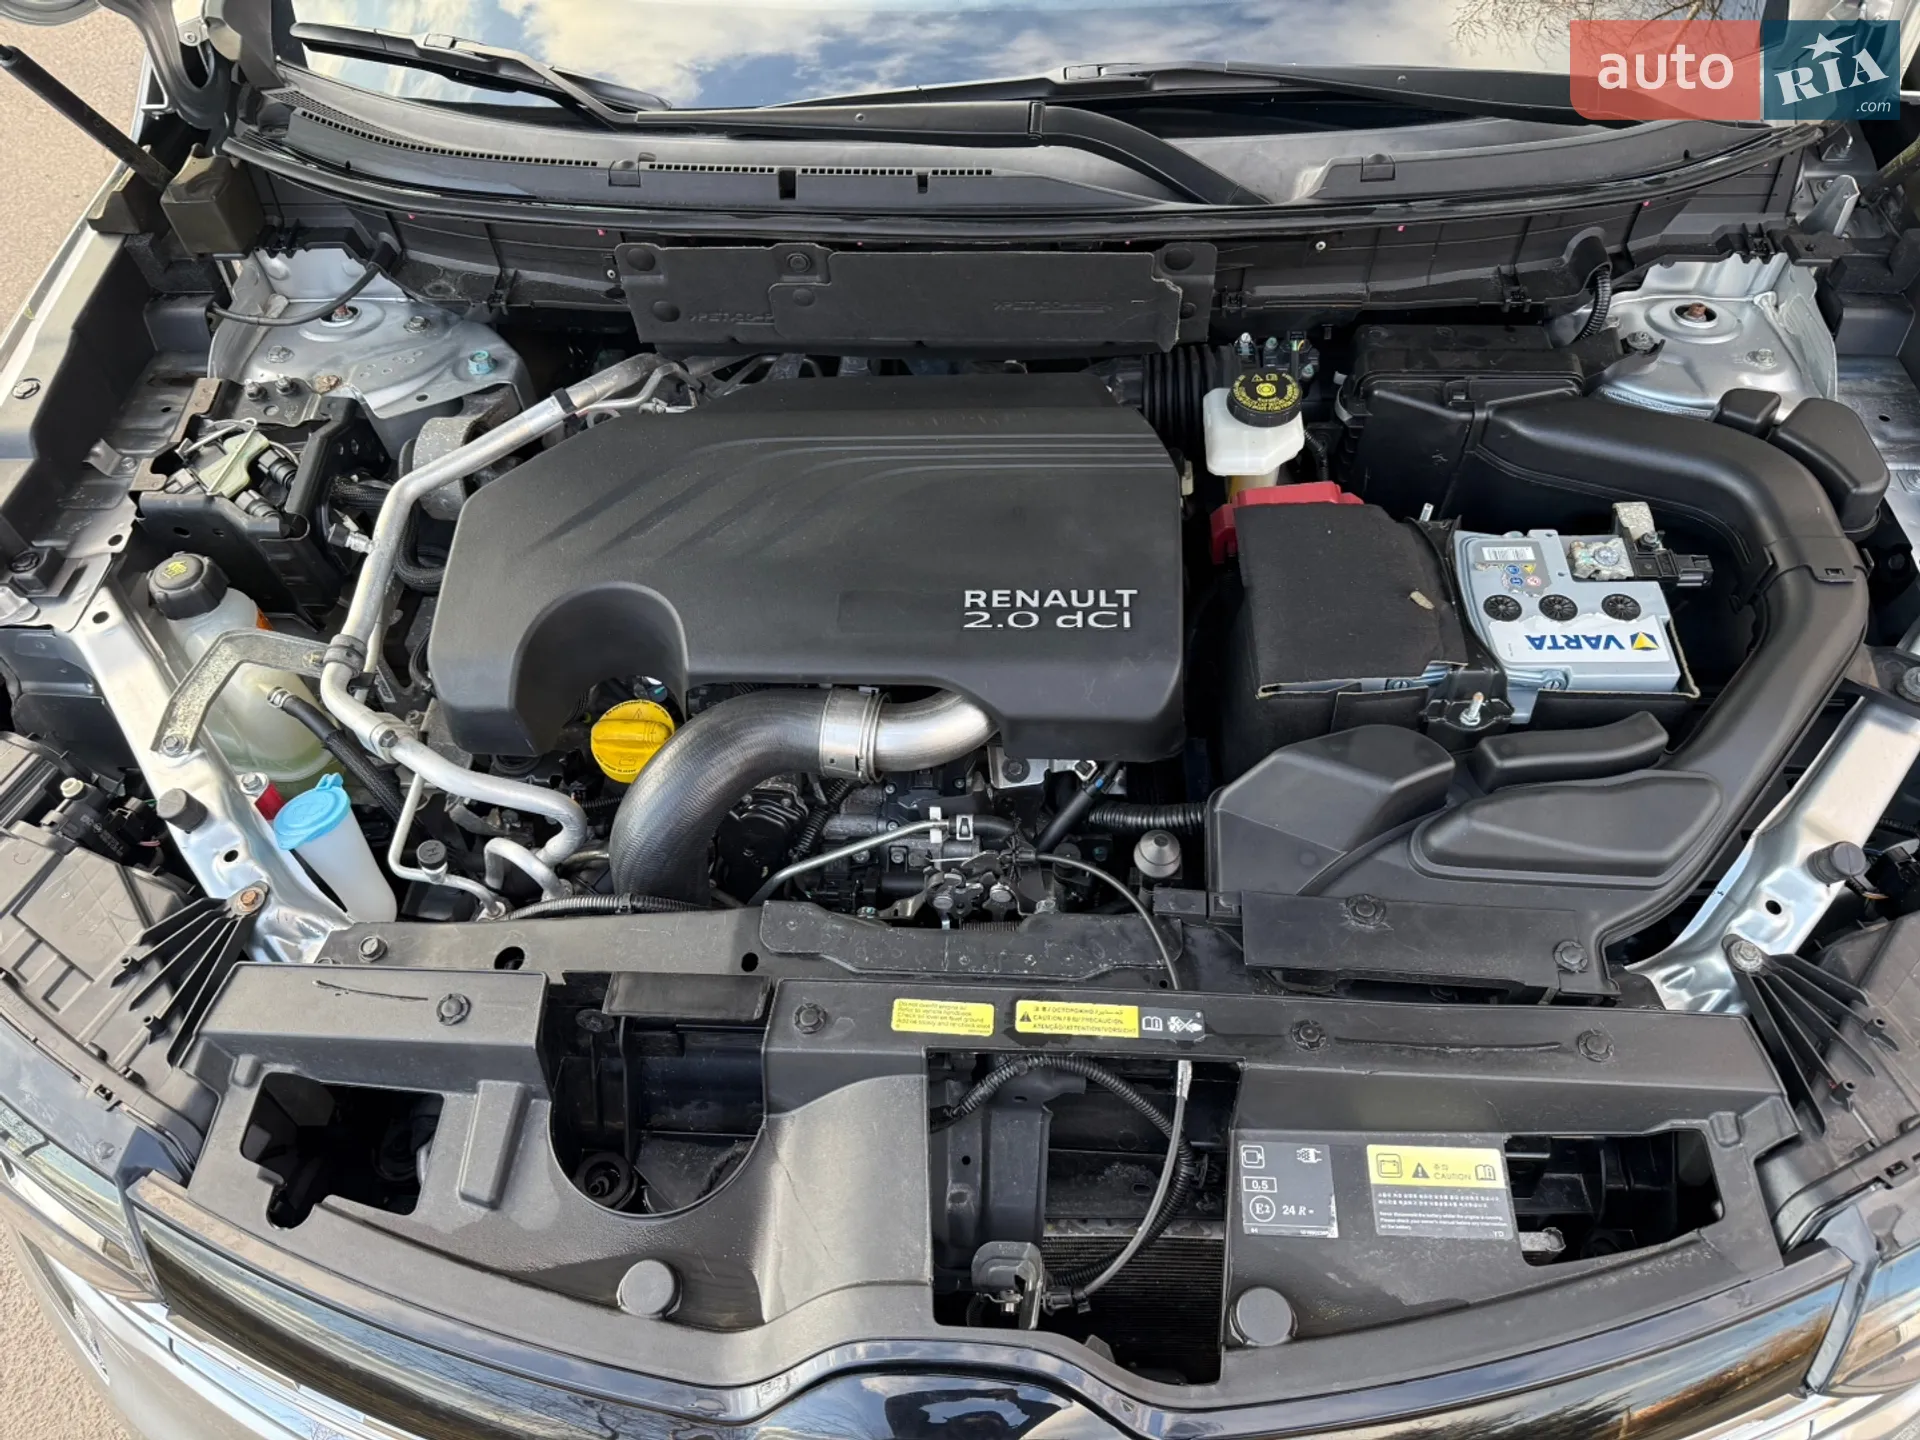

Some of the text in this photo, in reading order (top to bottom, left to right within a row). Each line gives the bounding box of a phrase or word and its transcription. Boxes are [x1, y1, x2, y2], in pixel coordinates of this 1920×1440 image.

[964, 589, 1138, 608] RENAULT
[963, 610, 1040, 628] 2.0
[1524, 634, 1626, 651] VARTA
[1433, 1172, 1472, 1181] CAUTION
[1282, 1204, 1296, 1215] 24
